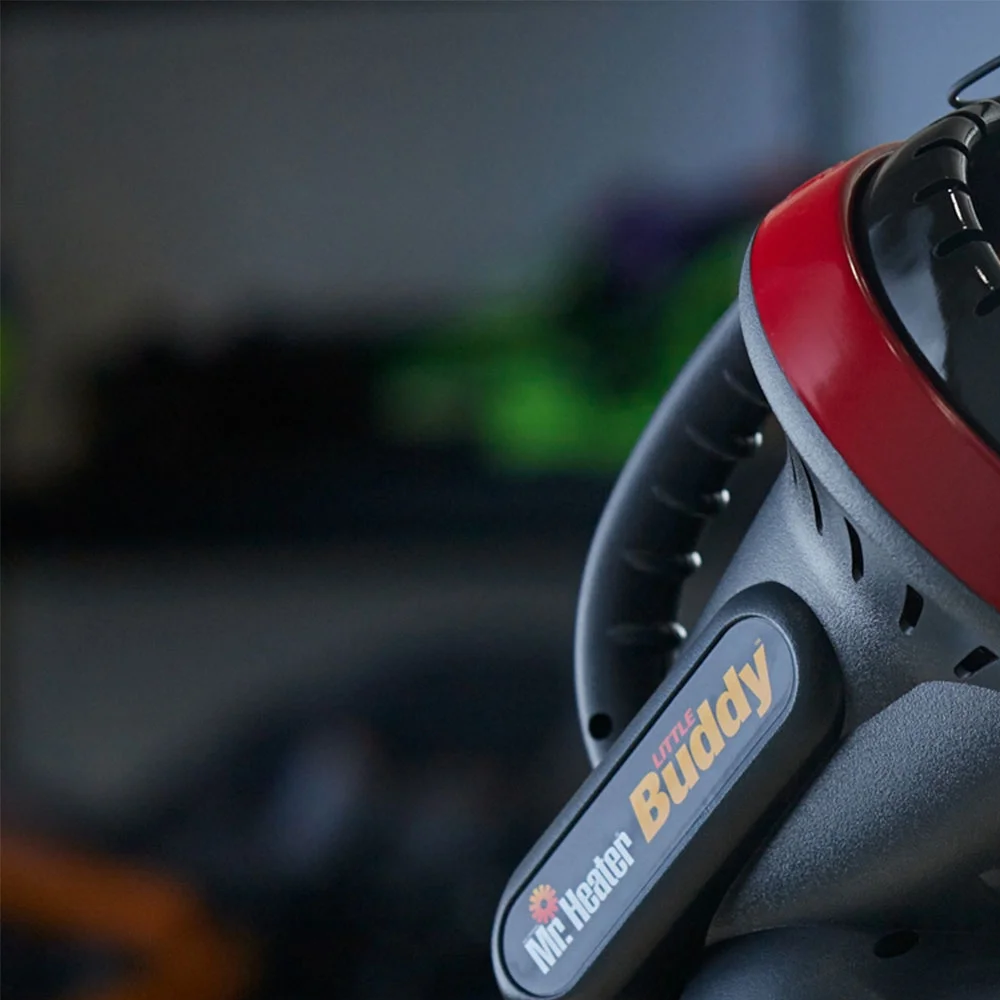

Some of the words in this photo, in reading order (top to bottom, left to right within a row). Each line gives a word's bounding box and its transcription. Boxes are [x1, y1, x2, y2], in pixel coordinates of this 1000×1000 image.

[629, 643, 772, 844] Buddy
[652, 708, 695, 769] LITTLE
[524, 917, 574, 975] Mr.
[558, 831, 635, 931] Heater
